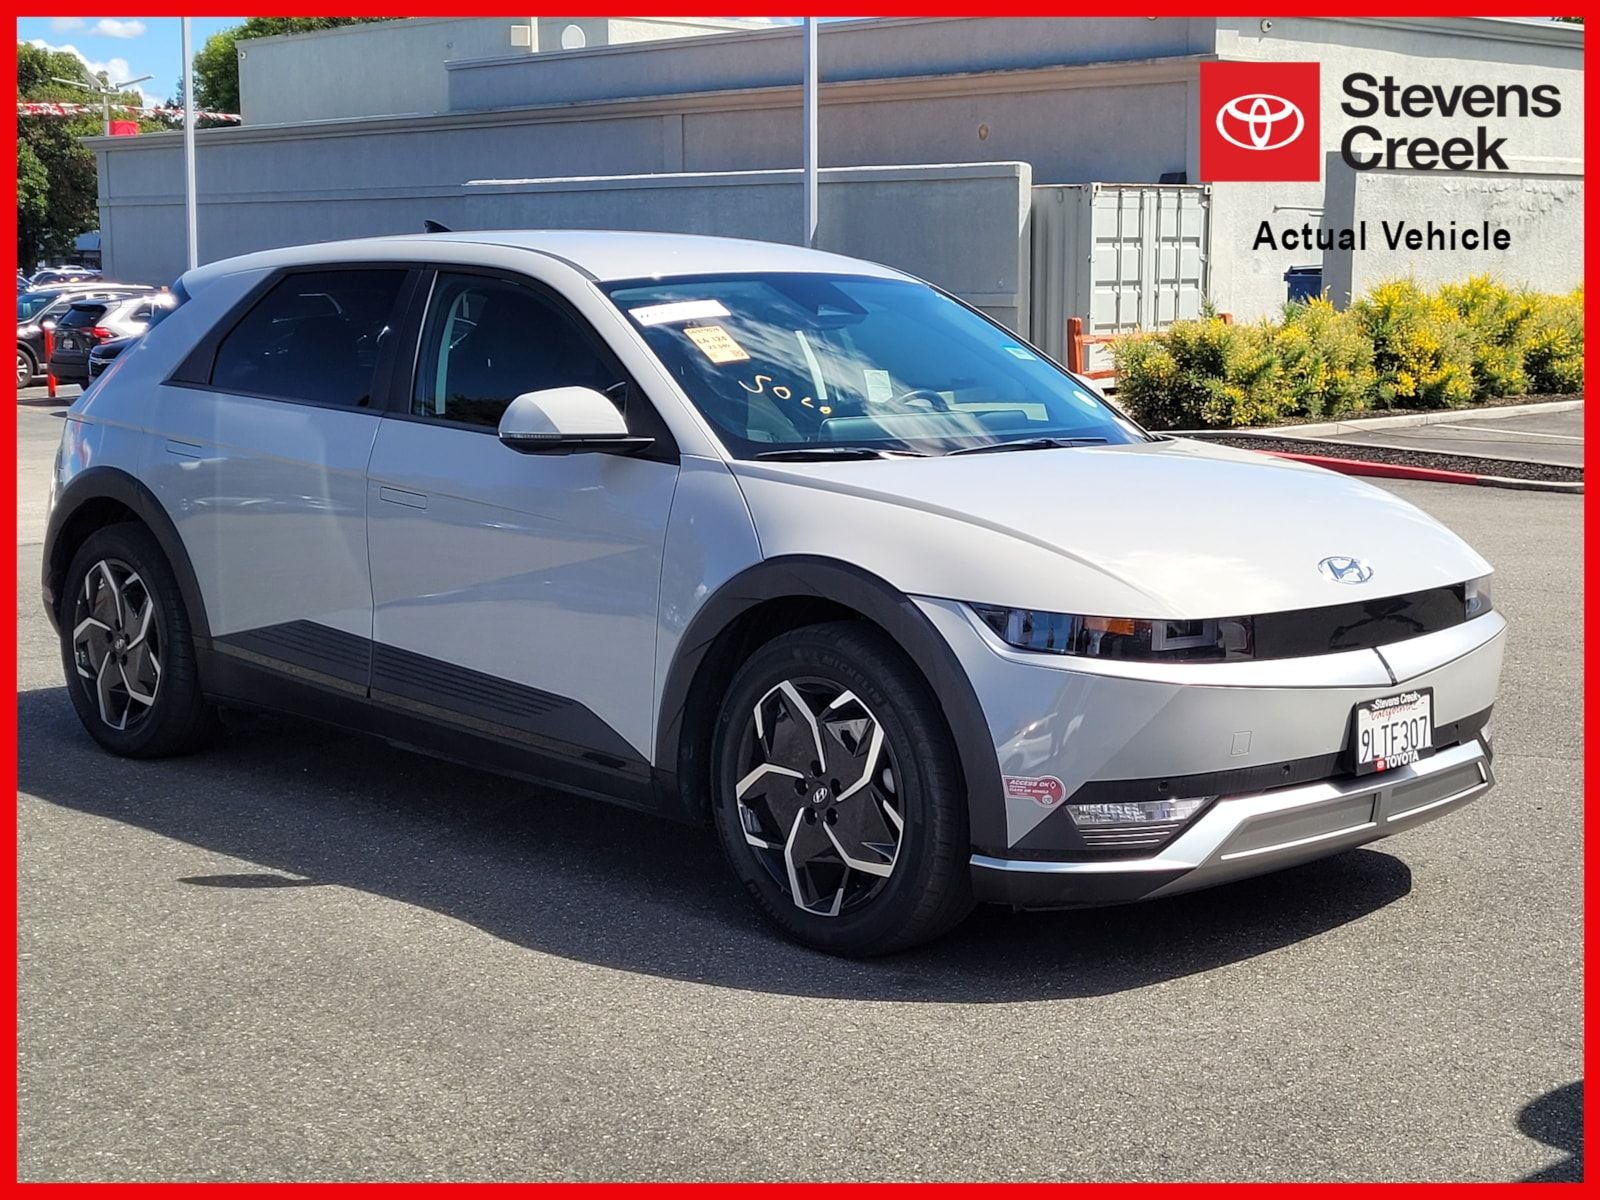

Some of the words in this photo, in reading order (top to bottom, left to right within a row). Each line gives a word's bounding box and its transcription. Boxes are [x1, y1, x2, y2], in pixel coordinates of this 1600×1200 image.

[1374, 697, 1400, 710] Stevens
[1400, 691, 1420, 704] Creek
[1362, 716, 1427, 762] 9LTF307
[1386, 750, 1420, 769] TOYOTA
